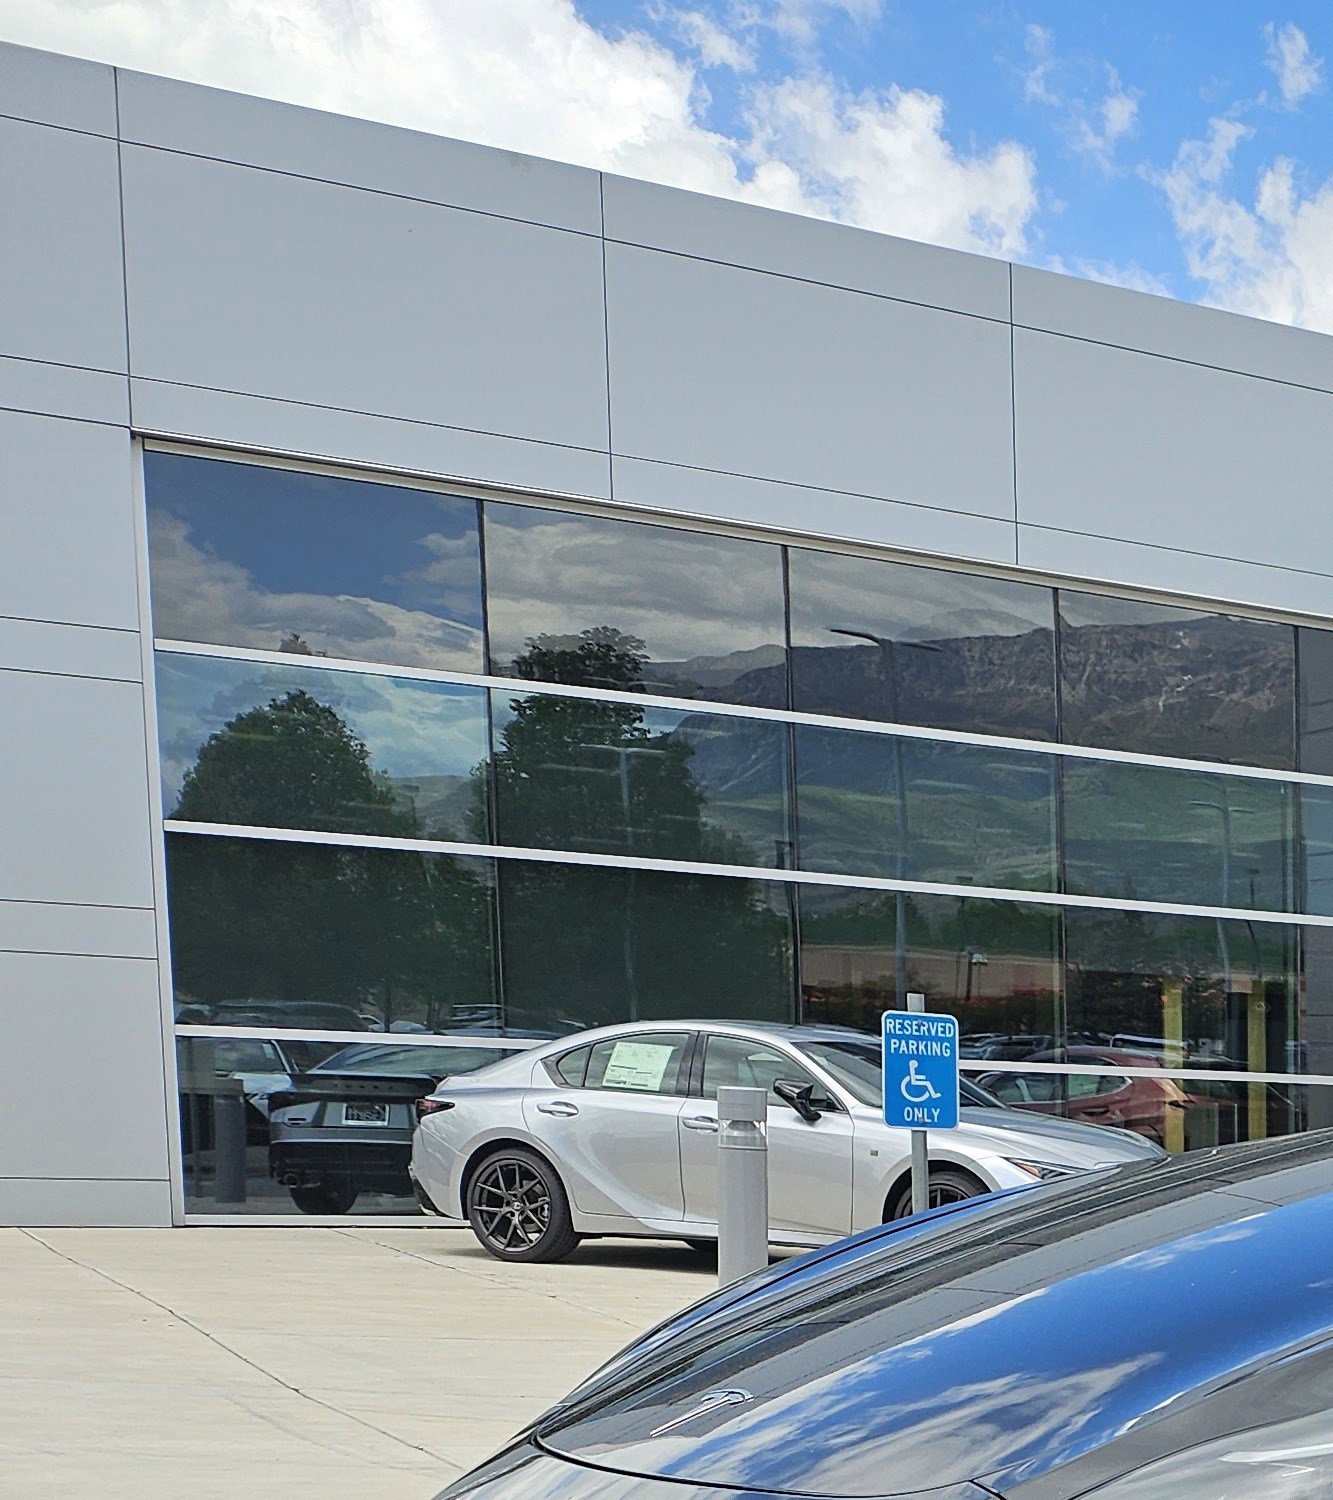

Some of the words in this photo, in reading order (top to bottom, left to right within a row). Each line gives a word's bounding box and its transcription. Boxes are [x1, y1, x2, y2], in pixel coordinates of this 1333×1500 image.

[886, 1018, 954, 1037] RESERVED
[890, 1039, 951, 1057] PARKING
[903, 1107, 941, 1123] ONLY
